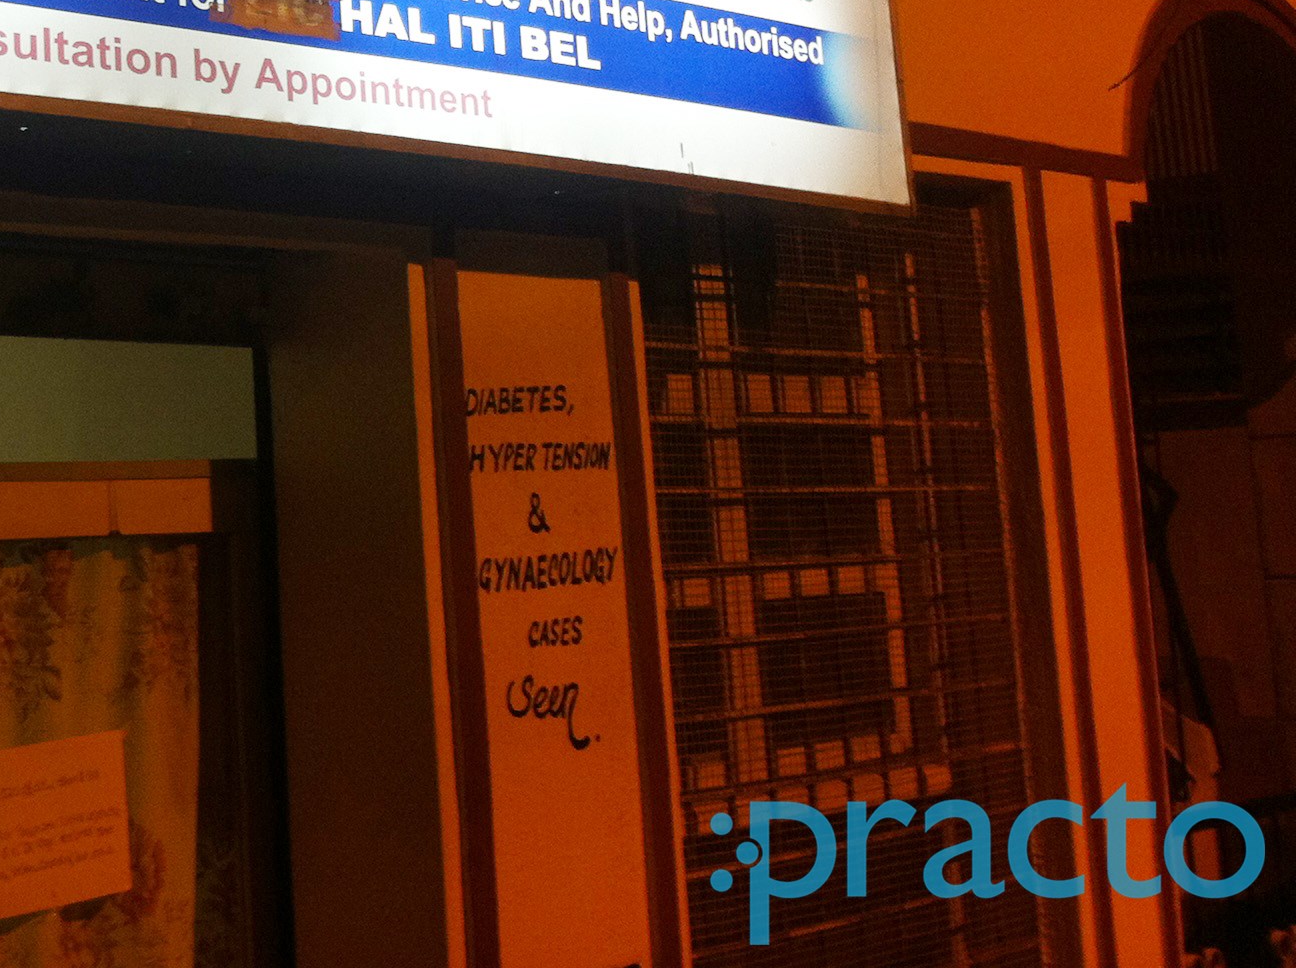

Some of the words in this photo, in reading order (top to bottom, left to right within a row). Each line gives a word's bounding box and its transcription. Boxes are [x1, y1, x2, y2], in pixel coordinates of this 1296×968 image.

[447, 13, 506, 56] ITI
[519, 26, 602, 71] BEL
[679, 8, 825, 66] Authorised
[193, 48, 241, 94] by
[255, 56, 493, 119] Appointment
[465, 384, 575, 417] DIABETES,
[470, 442, 536, 473] HYPER
[542, 441, 611, 471] TENSION
[527, 492, 551, 534] &
[478, 545, 619, 594] GYNAECOLOGY
[527, 615, 584, 648] CASES
